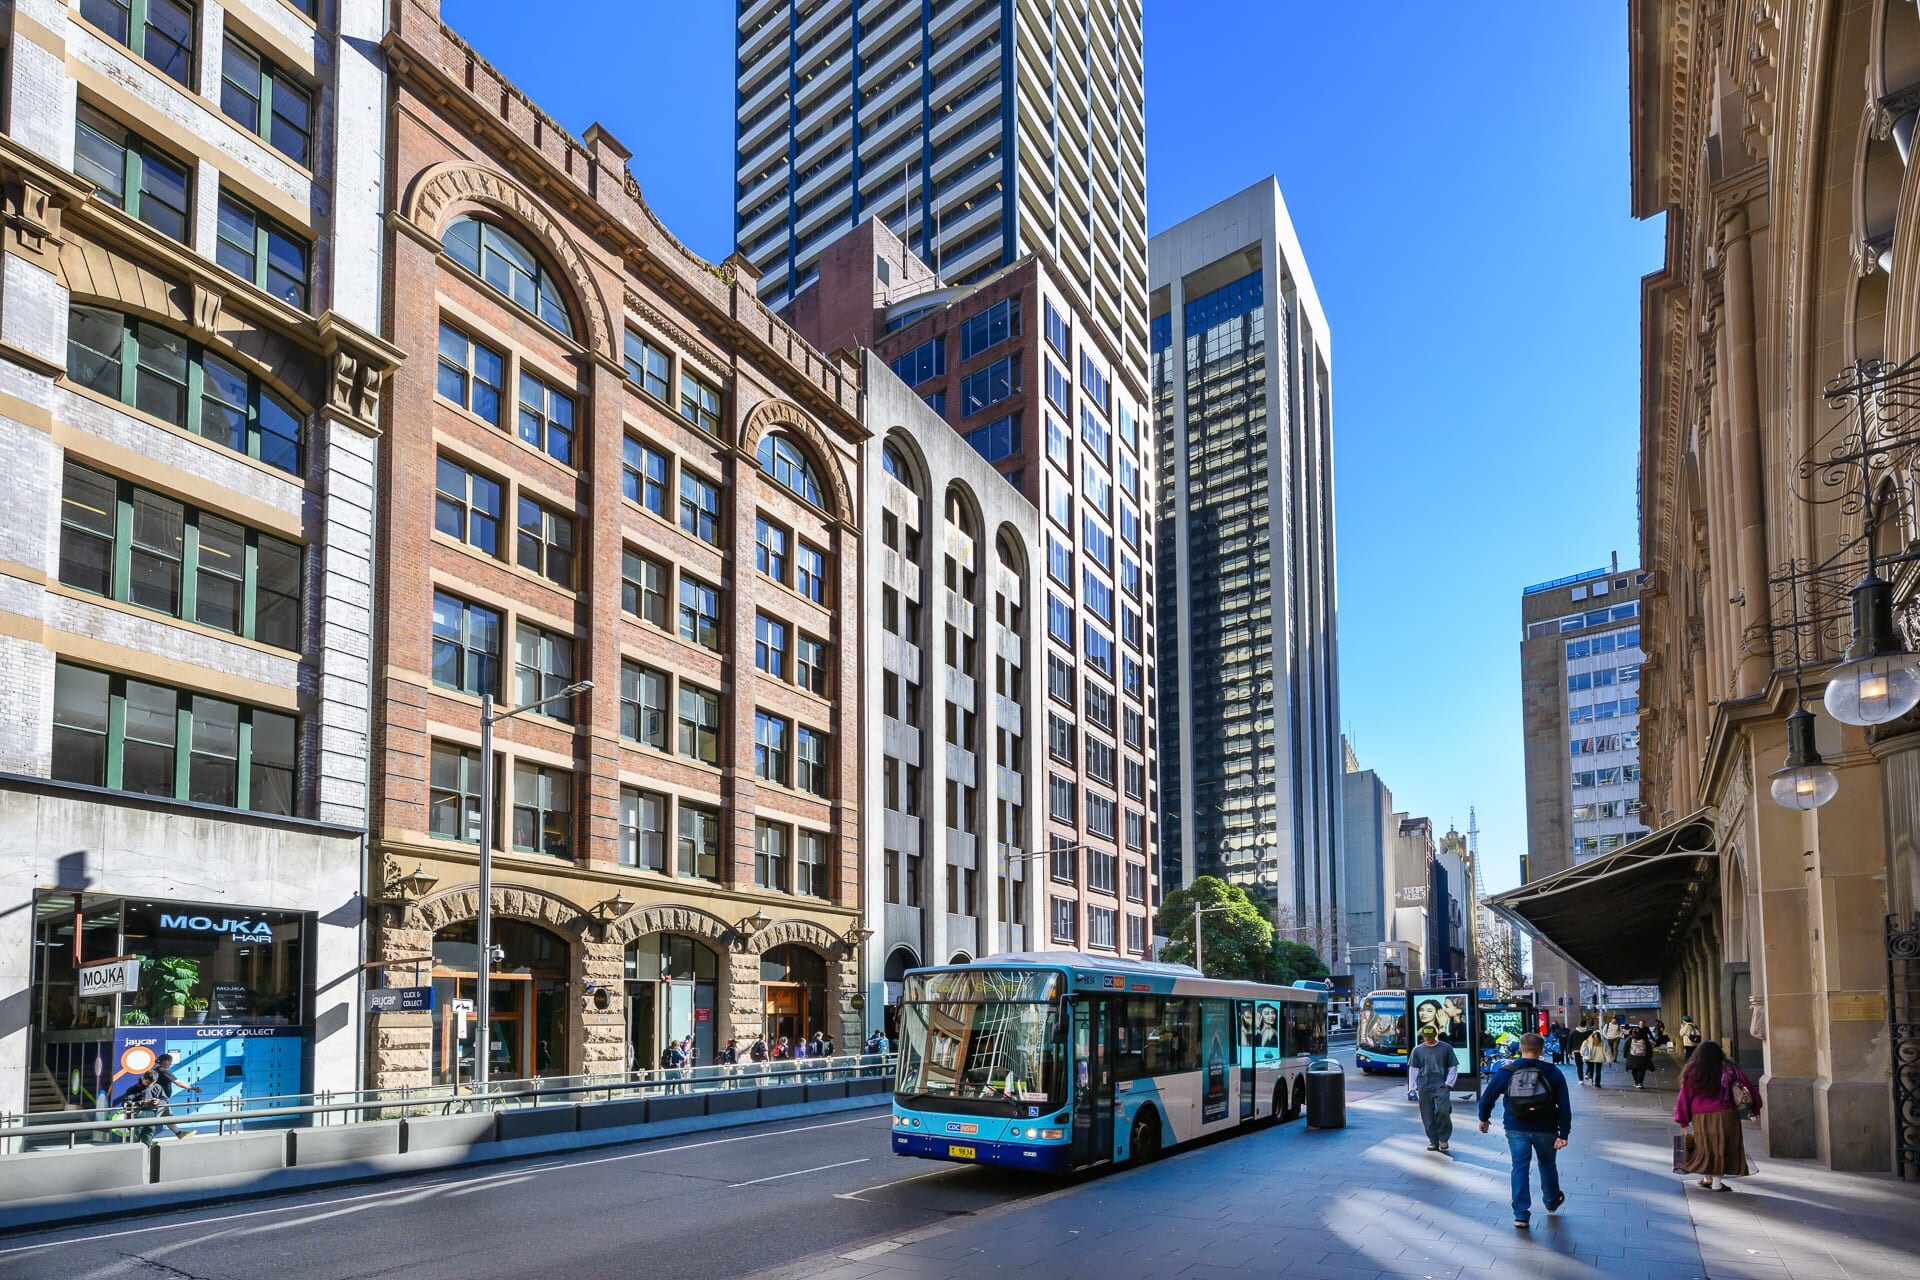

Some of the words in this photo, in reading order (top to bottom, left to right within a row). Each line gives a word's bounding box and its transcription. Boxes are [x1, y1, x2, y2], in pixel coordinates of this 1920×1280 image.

[160, 914, 273, 935] MOJKA
[232, 933, 272, 943] HAIR
[83, 966, 124, 987] MOJKA
[370, 994, 396, 1008] jaycar
[196, 1029, 223, 1037] CLICK
[236, 1028, 275, 1036] COLLECT
[124, 1037, 157, 1047] jaycar
[958, 1148, 973, 1156] 9834
